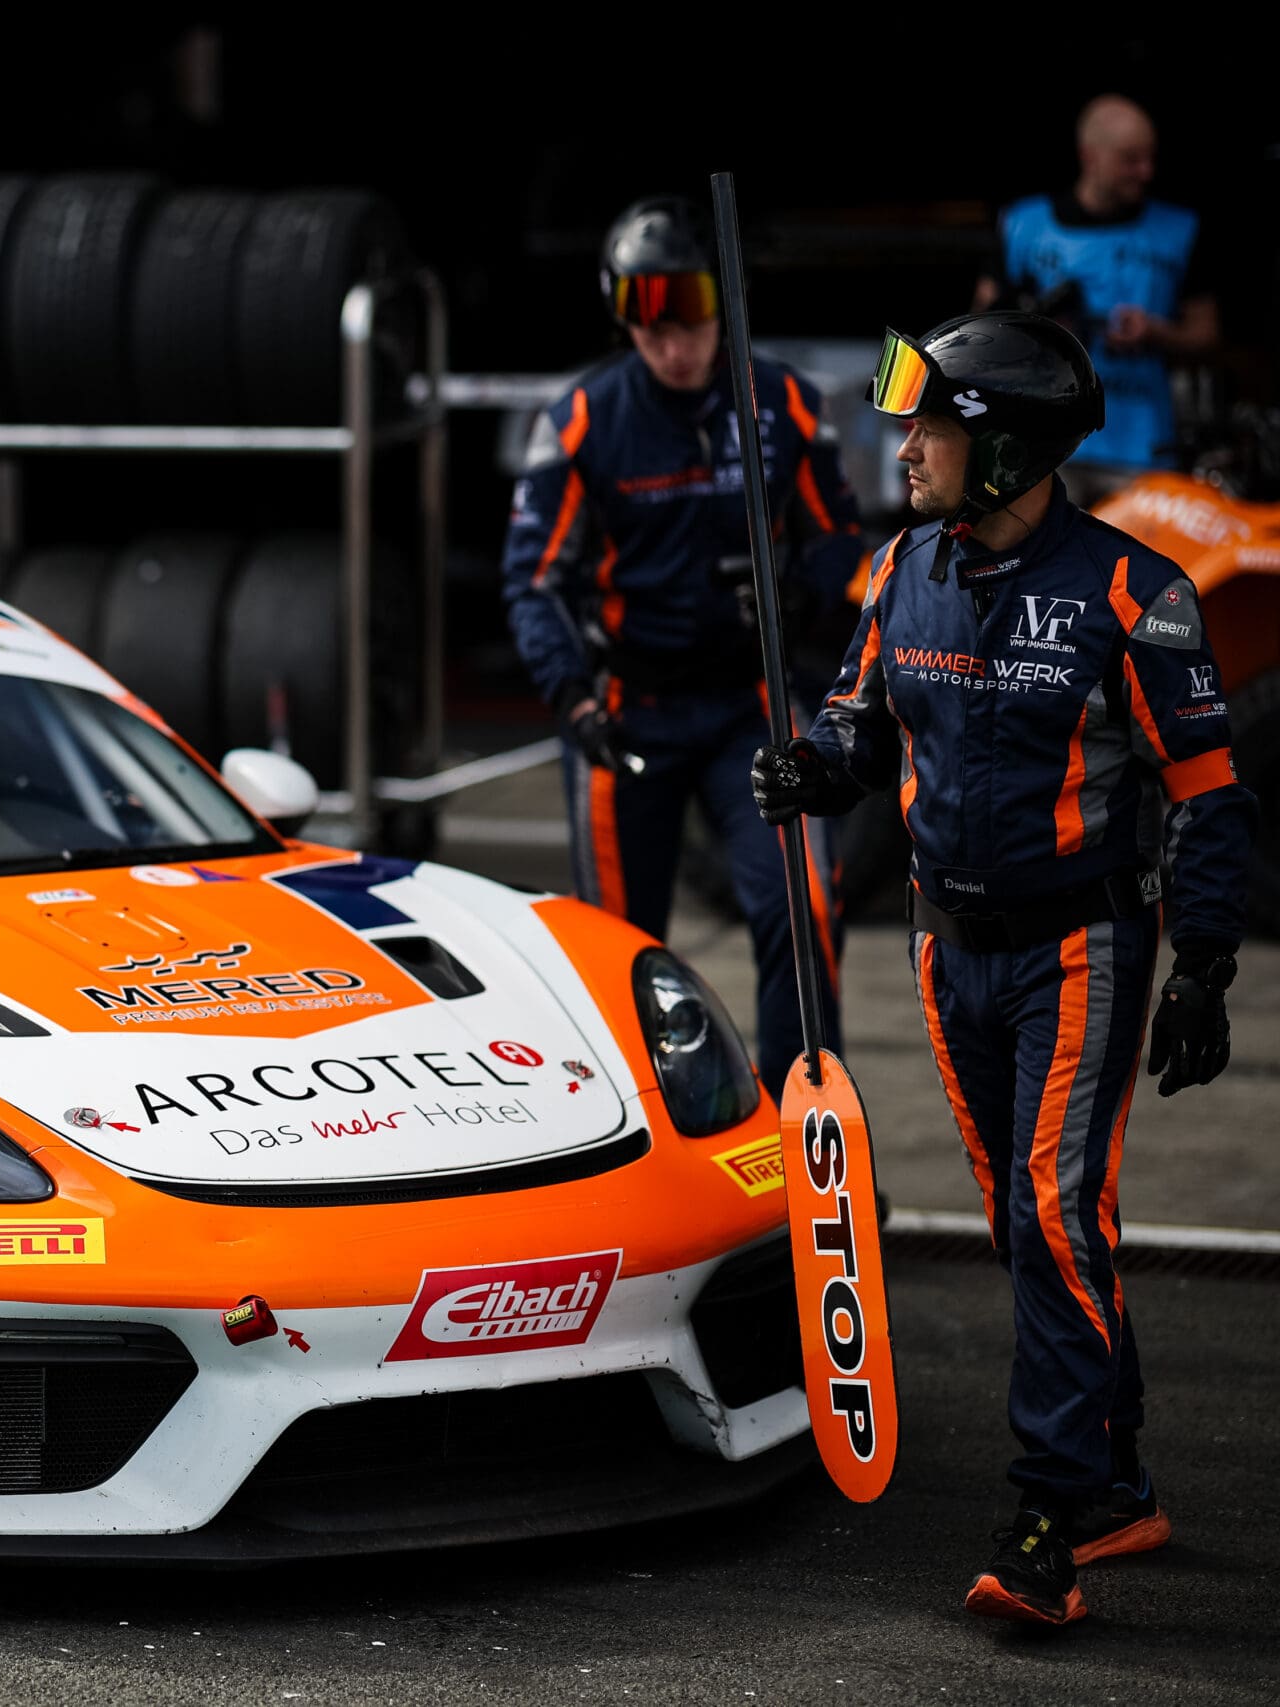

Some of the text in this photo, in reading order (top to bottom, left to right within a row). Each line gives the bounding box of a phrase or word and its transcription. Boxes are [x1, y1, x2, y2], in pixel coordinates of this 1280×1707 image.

[1146, 615, 1191, 638] freem
[894, 647, 1075, 686] WIMMER WERK
[917, 670, 1033, 694] MOTORSPORT
[944, 878, 985, 894] Daniel
[76, 967, 365, 1011] MERED
[110, 1005, 233, 1026] PREMIUM
[133, 1051, 531, 1125] ARCOTEL
[208, 1098, 540, 1157] Das mehr Hotel
[725, 1143, 784, 1187] PIRE
[802, 1106, 876, 1463] STOP
[225, 1304, 252, 1323] OMP
[422, 1271, 602, 1343] Eibach
